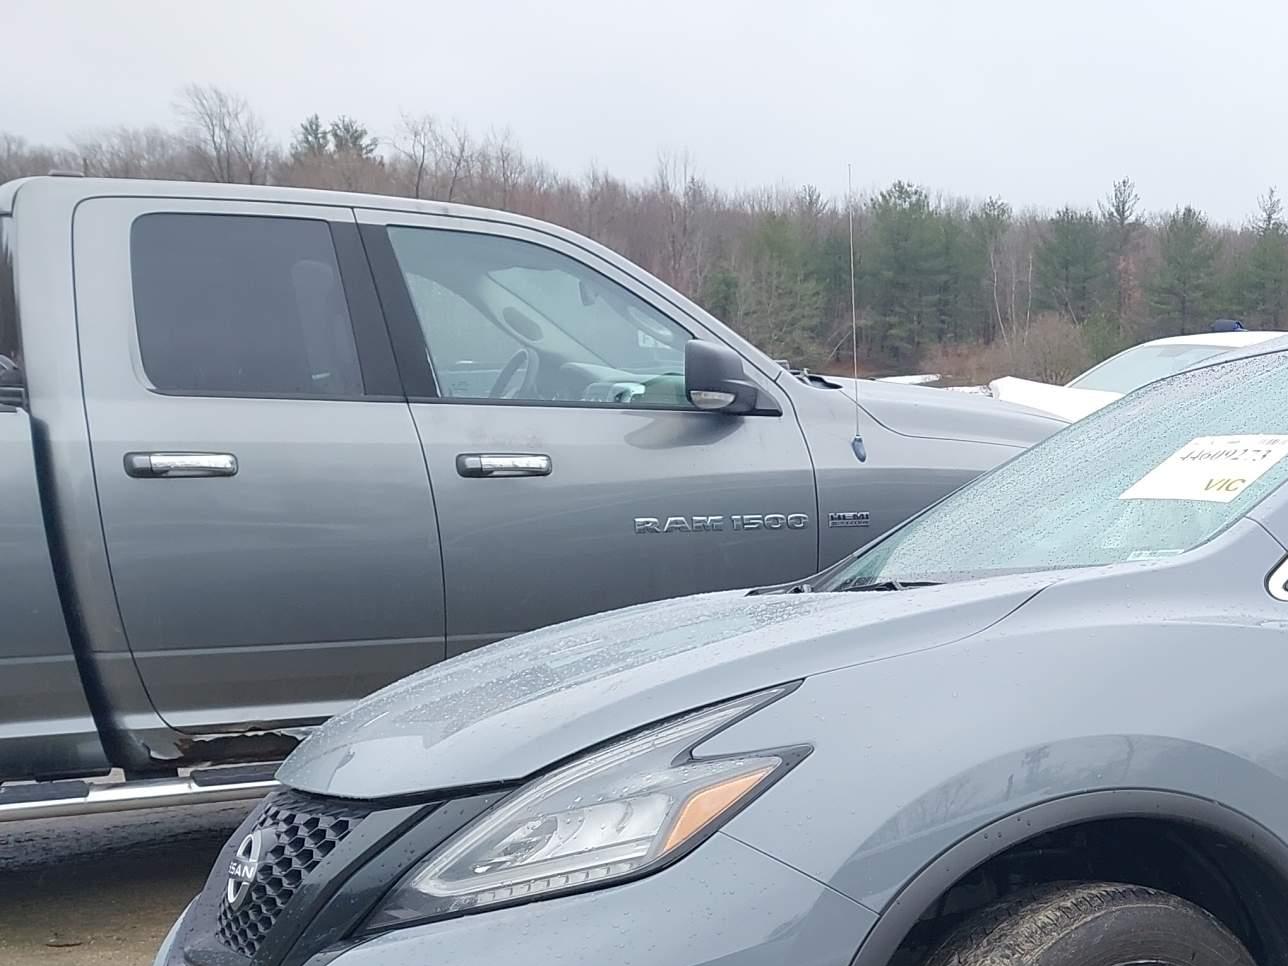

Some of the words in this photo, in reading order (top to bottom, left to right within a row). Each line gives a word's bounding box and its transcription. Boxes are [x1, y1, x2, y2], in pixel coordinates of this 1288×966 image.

[1203, 477, 1247, 493] VIC
[633, 515, 724, 534] RAM
[730, 513, 809, 531] 1500
